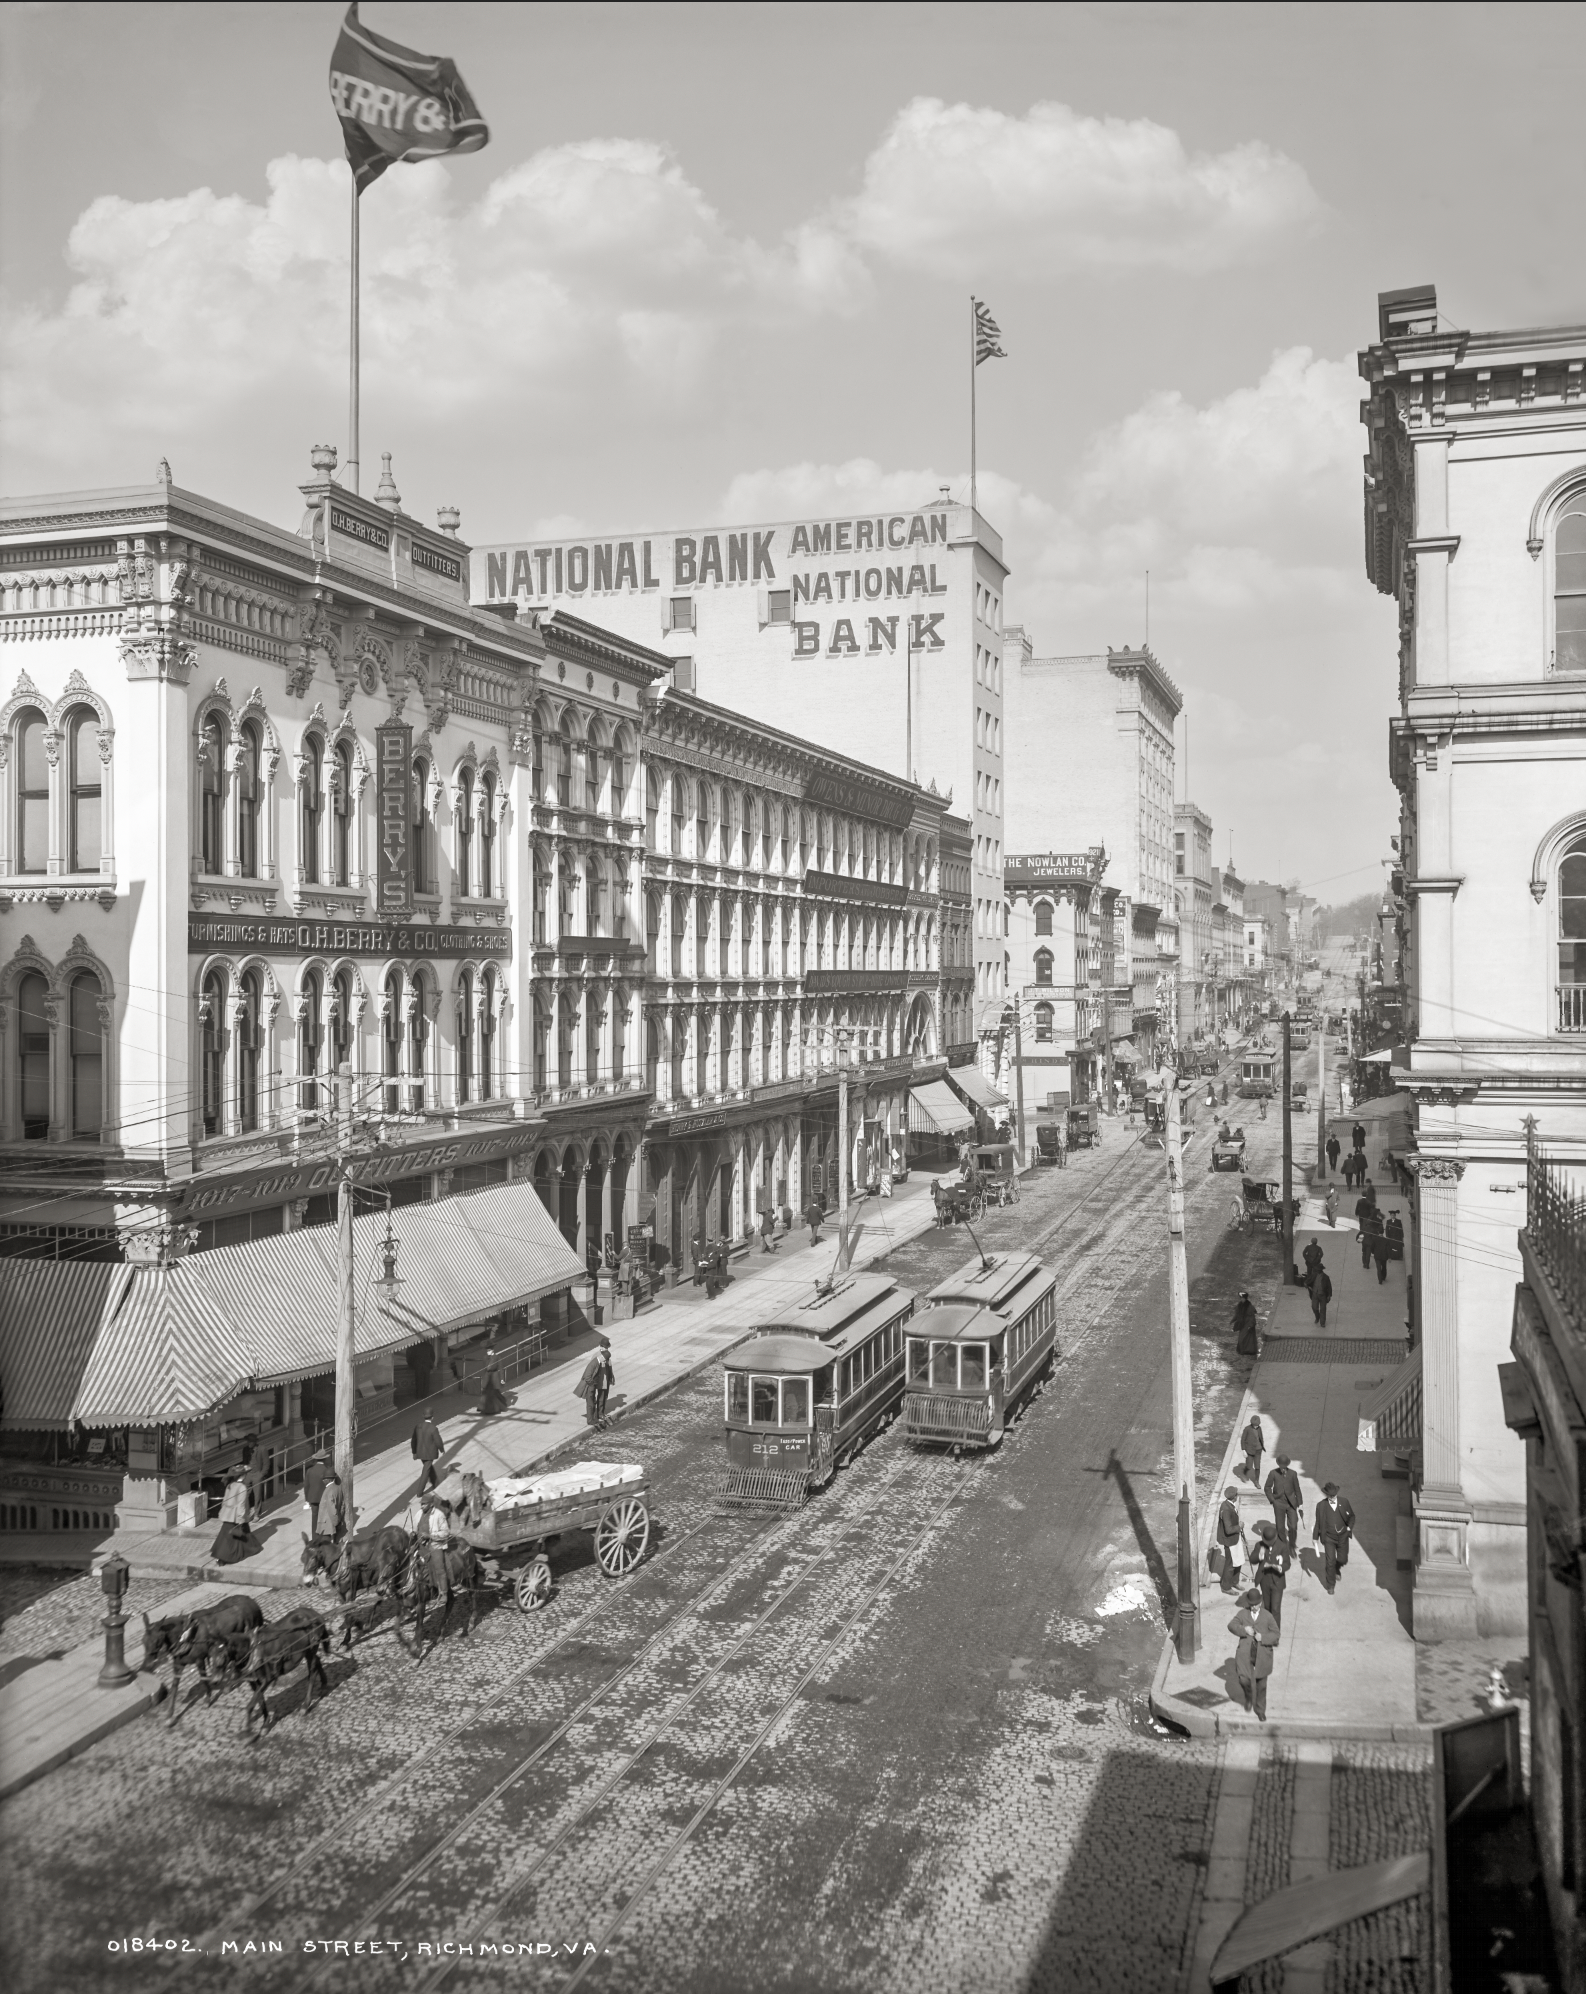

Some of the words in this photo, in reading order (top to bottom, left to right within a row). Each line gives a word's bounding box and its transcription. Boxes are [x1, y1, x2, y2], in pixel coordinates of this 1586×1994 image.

[413, 97, 447, 133] &
[788, 513, 947, 559] AMERICAN
[486, 539, 660, 606] NATIONAL
[672, 529, 776, 592] BANK
[790, 563, 948, 606] NATIONAL
[790, 612, 946, 661] BANK
[812, 776, 847, 804] OWENS
[844, 788, 855, 807] &
[853, 790, 881, 816] MINOR
[383, 735, 406, 906] BERRY'S
[1027, 858, 1068, 867] NOWLAN
[1071, 857, 1087, 866] CO.
[1033, 867, 1086, 876] JEWELERS.
[808, 875, 861, 896] IMPORTERS
[870, 885, 905, 902] JOBBERS
[258, 926, 267, 942] &
[270, 926, 296, 944] HATS
[398, 931, 411, 950] &
[440, 934, 475, 949] CLOTHING
[476, 935, 483, 947] &
[484, 935, 508, 949] SHOES
[188, 1174, 303, 1211] 1017-1019
[752, 1443, 779, 1455] 212
